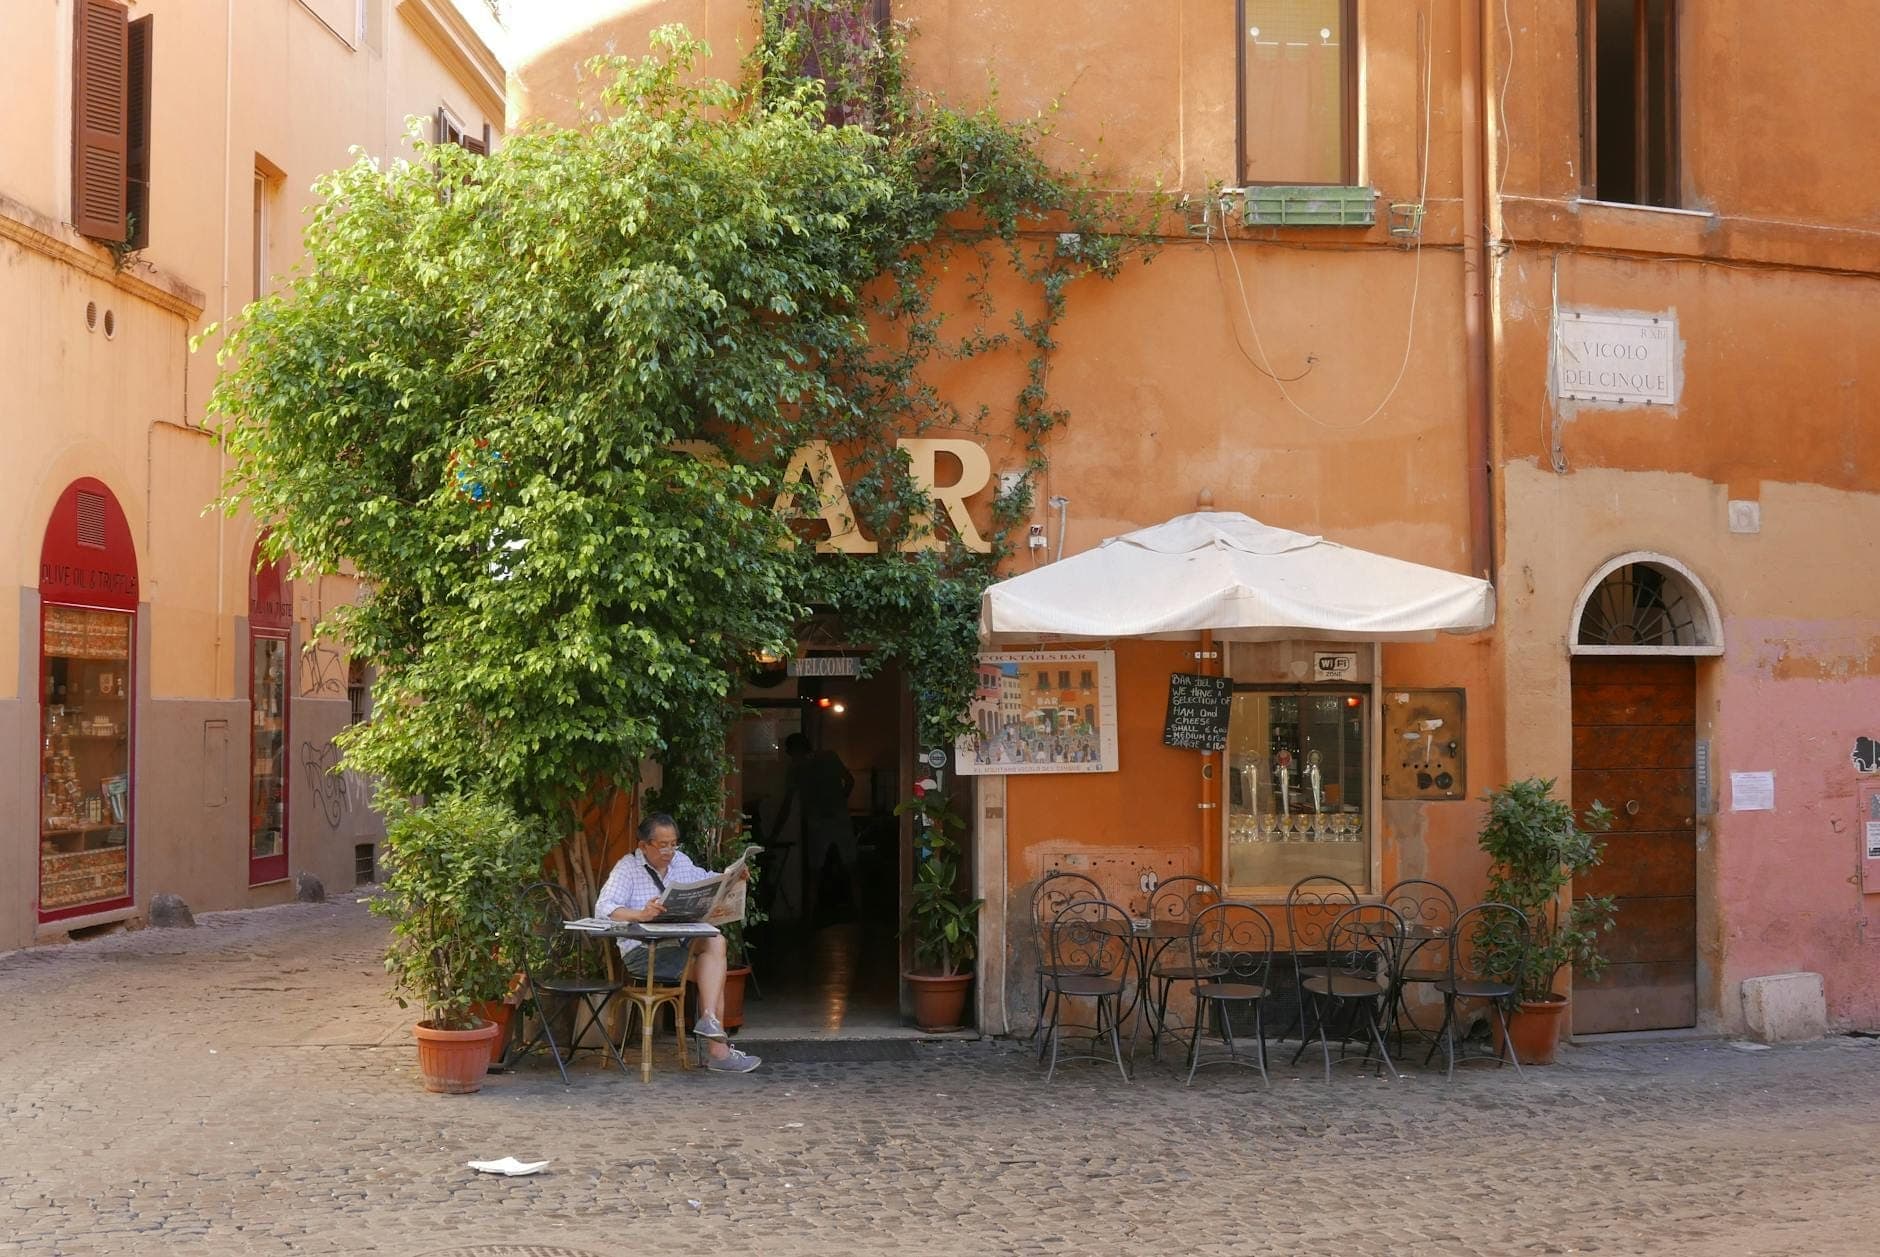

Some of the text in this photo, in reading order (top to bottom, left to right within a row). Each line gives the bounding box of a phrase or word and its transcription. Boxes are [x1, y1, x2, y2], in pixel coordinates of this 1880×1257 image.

[1582, 342, 1648, 360] VICOLO
[1565, 369, 1666, 392] DEL CINQUE
[42, 563, 71, 586] OLIVE
[73, 567, 88, 589] OIL
[980, 654, 1057, 662] COCKTAILS
[796, 658, 854, 676] WELCOME
[1171, 673, 1191, 685] BAR
[1172, 686, 1187, 696] WE
[1037, 697, 1059, 705] BAR
[1172, 696, 1232, 705] SELECTION OF
[1173, 706, 1194, 717] HAM
